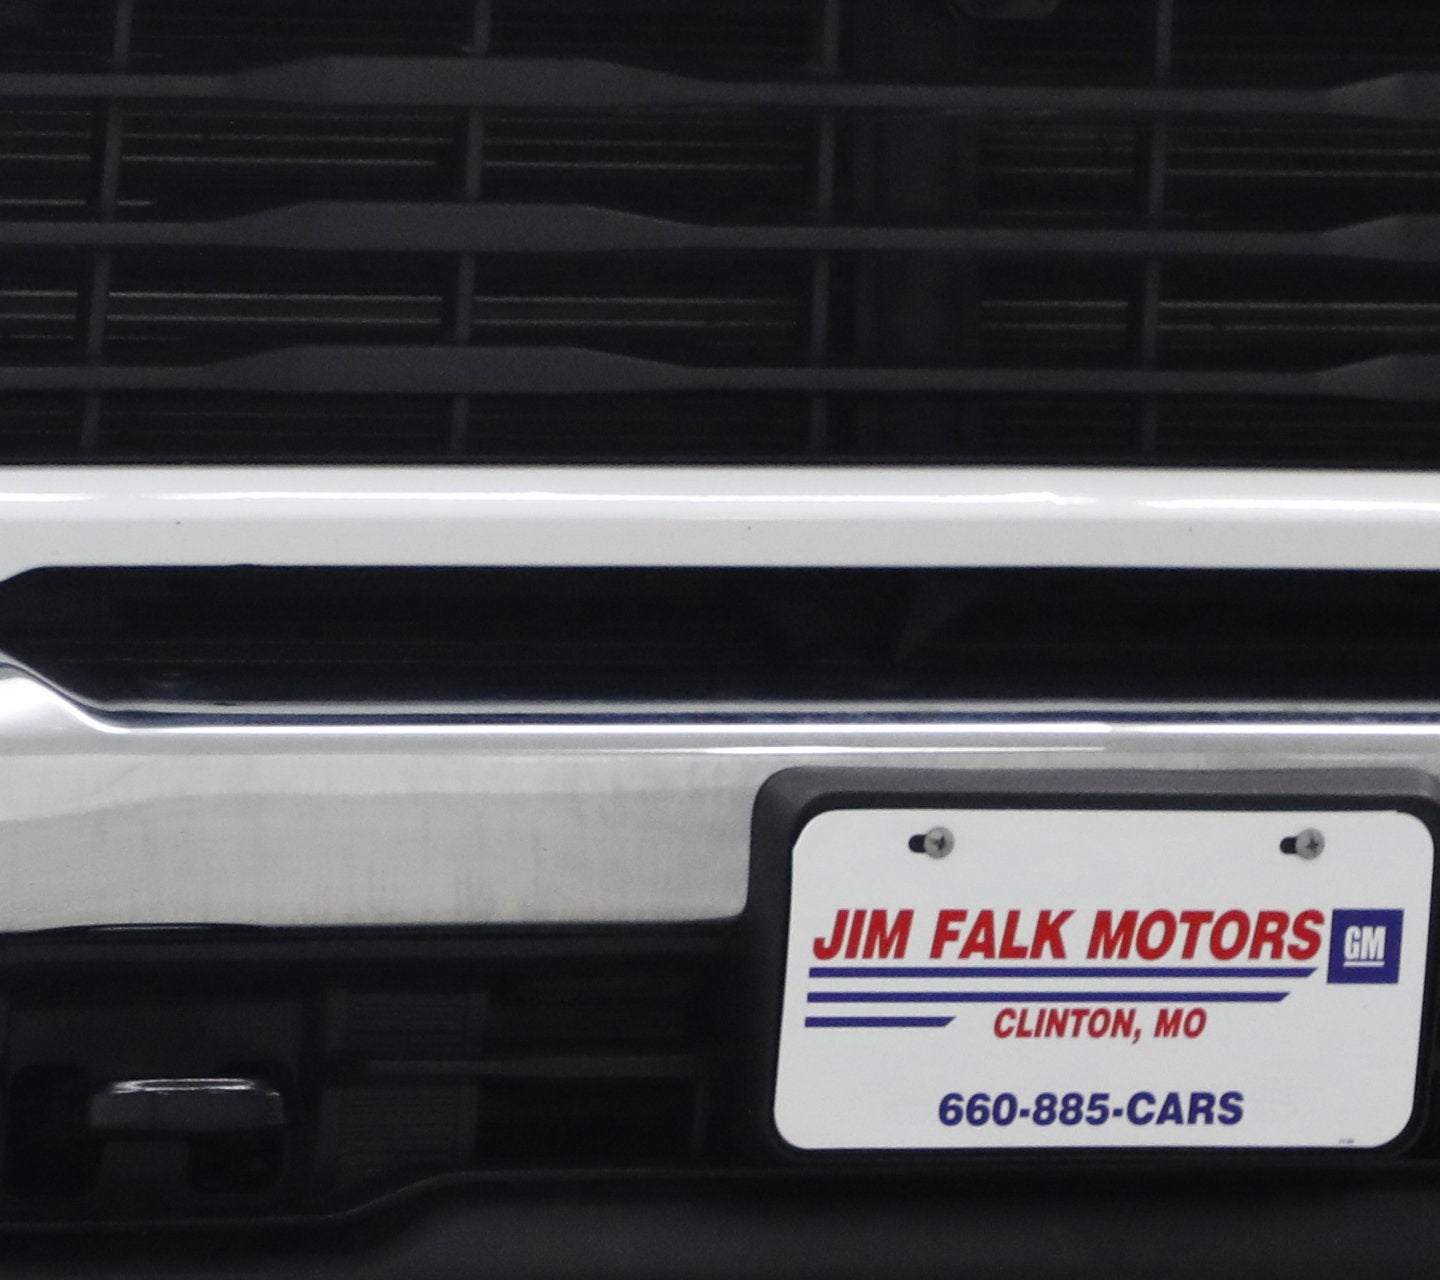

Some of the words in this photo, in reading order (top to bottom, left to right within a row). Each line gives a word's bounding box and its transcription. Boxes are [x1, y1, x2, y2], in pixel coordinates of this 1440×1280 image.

[814, 909, 914, 960] JIM
[930, 909, 1076, 960] FALK
[1087, 909, 1325, 960] MOTORS
[1343, 925, 1386, 963] GM
[993, 1008, 1144, 1044] CLINTON,
[1154, 1008, 1208, 1038] MO
[938, 1091, 1246, 1127] 660-885-CARS
